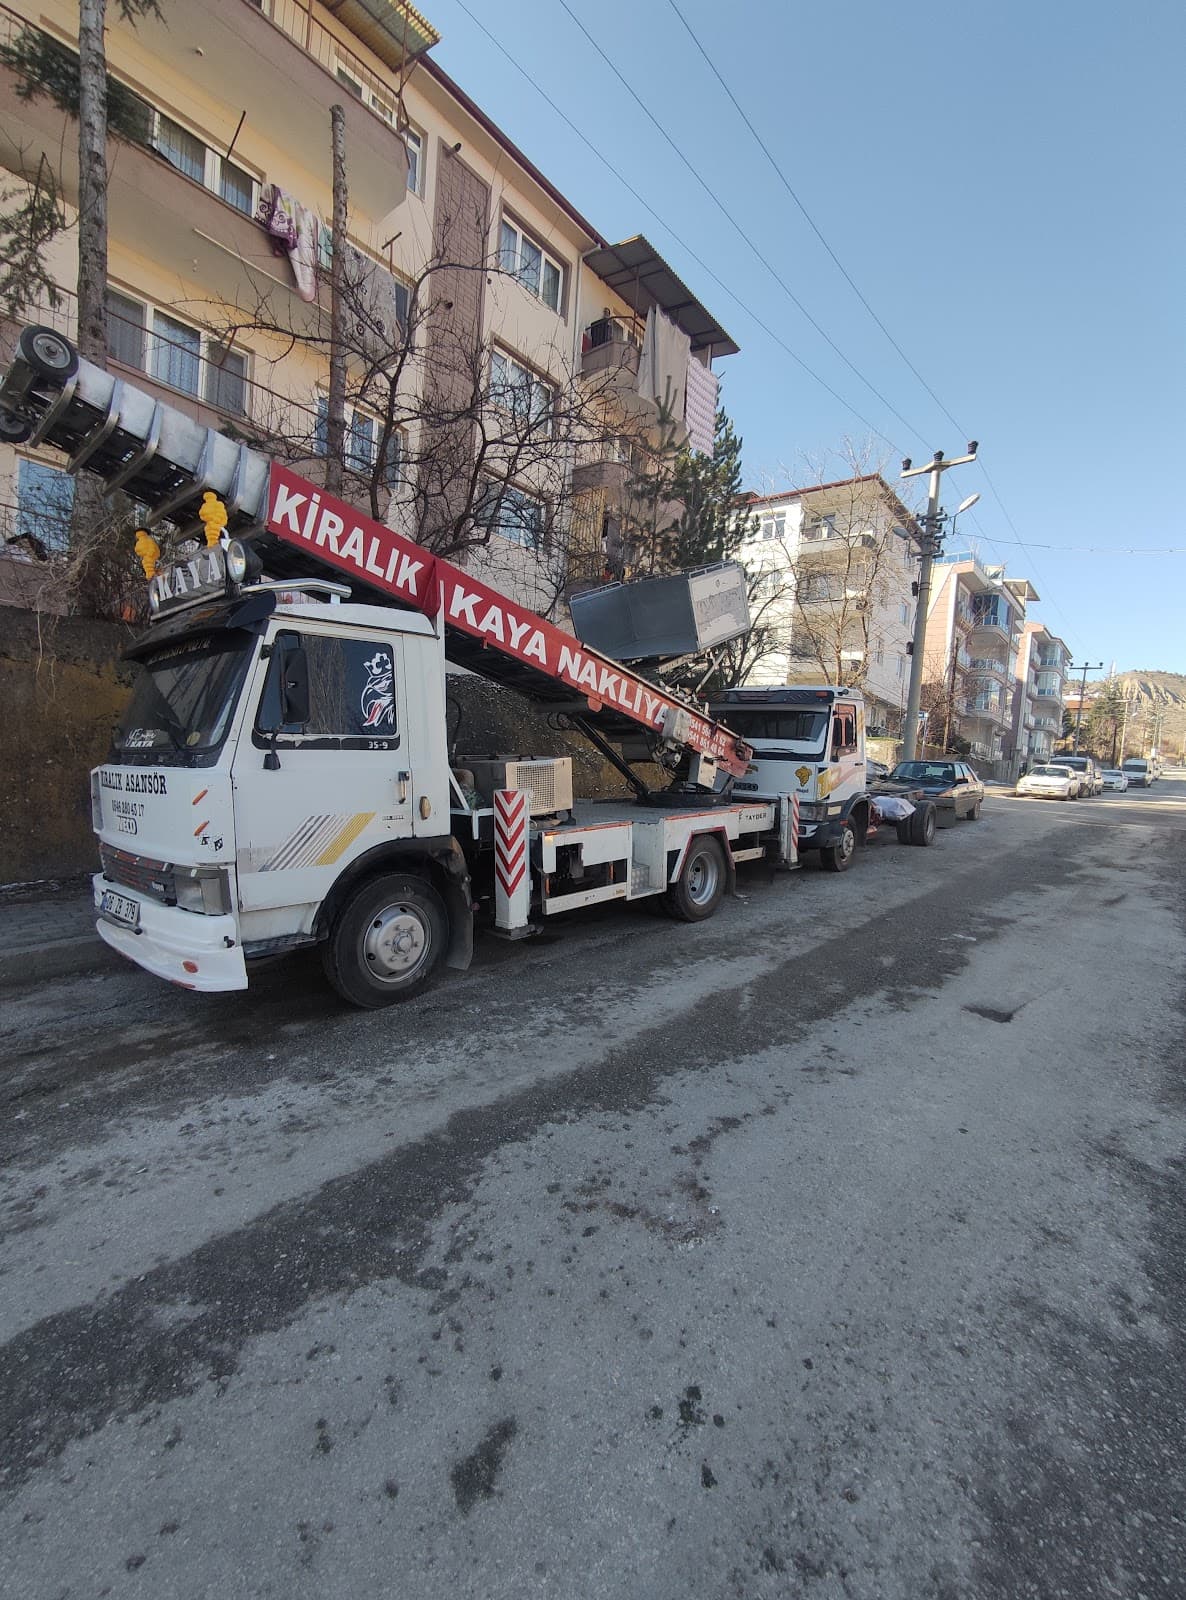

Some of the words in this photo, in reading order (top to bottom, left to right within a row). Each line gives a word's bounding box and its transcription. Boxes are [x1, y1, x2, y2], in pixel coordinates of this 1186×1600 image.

[156, 551, 222, 602] KAYA
[271, 483, 425, 598] KİRALIK
[449, 583, 548, 666] KAYA
[368, 741, 389, 749] 35-9
[125, 771, 167, 795] ASANSÖR
[125, 901, 136, 920] 379
